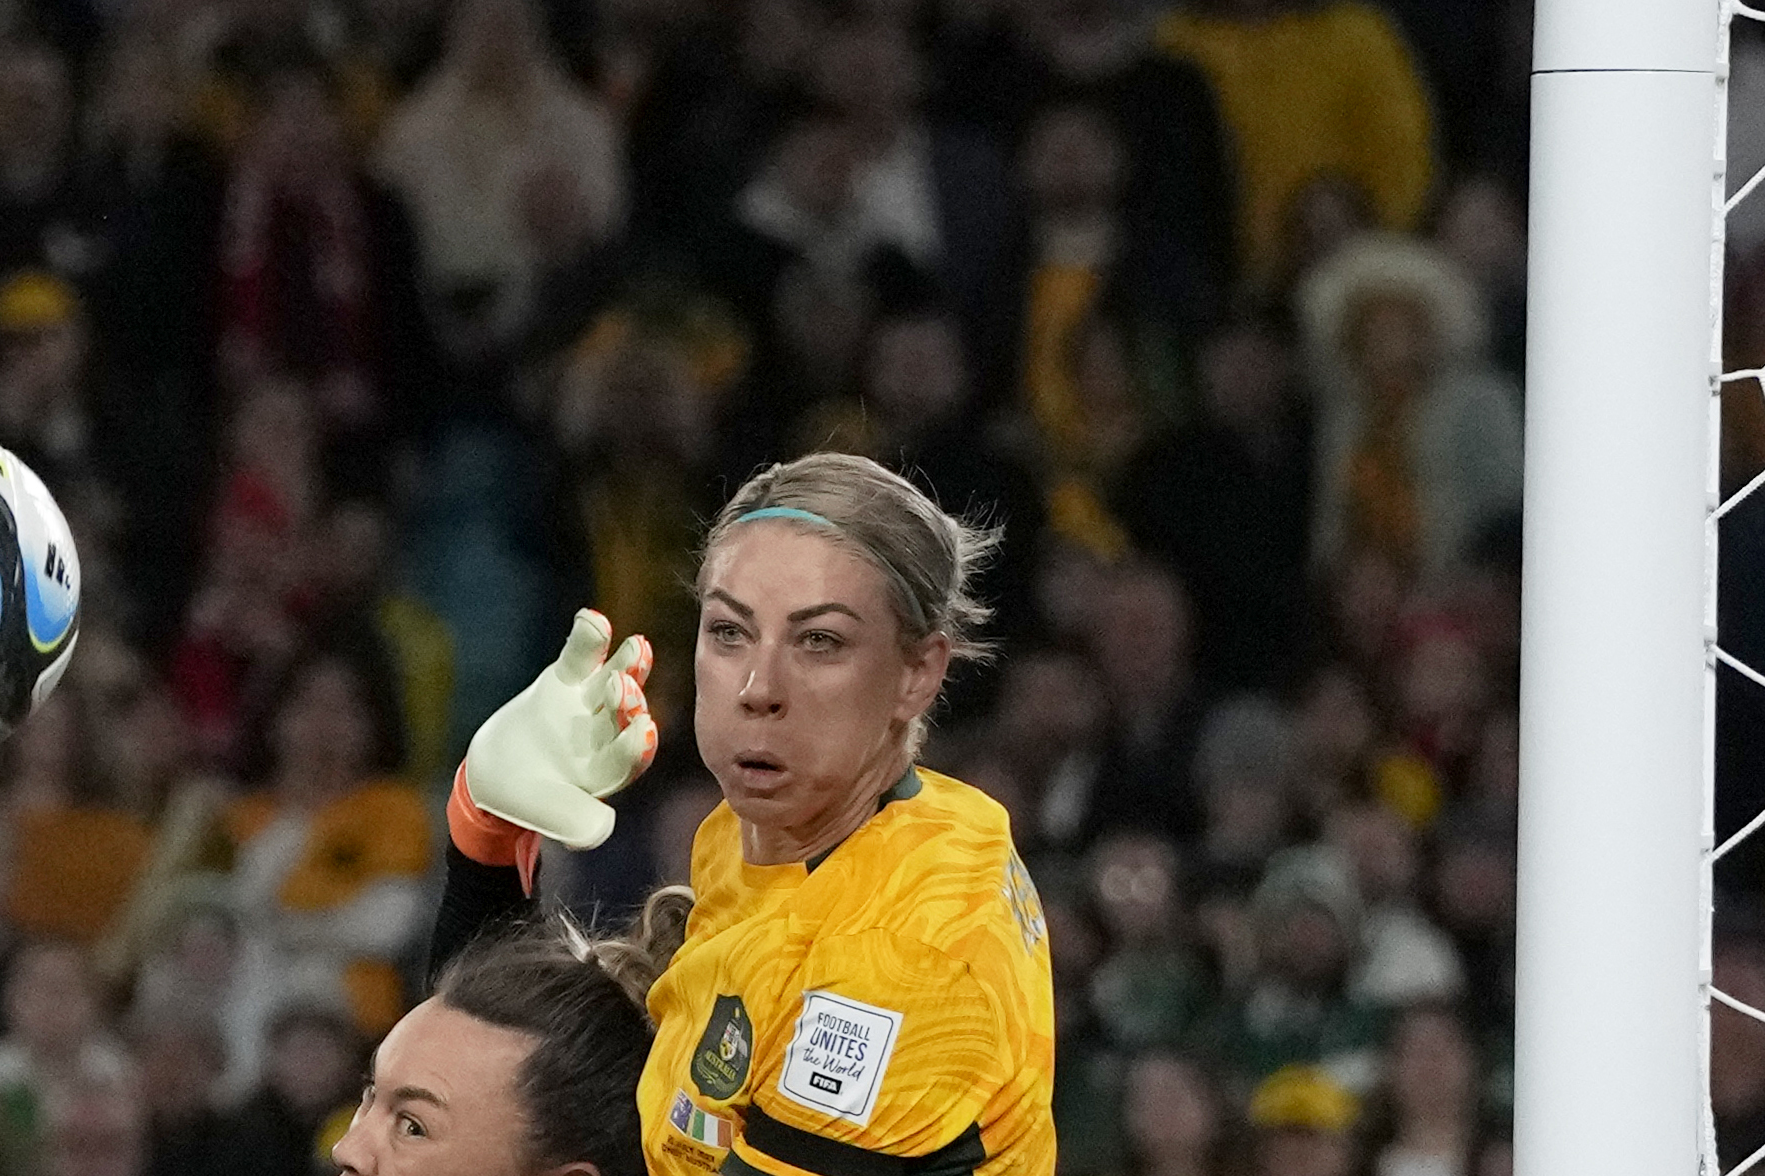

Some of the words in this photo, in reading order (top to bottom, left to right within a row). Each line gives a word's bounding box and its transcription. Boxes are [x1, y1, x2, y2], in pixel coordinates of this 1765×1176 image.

[818, 1012, 871, 1042] FOOTBALL
[809, 1026, 868, 1062] UNITES
[802, 1047, 821, 1066] the
[822, 1054, 866, 1082] World
[811, 1073, 840, 1093] FIFA
